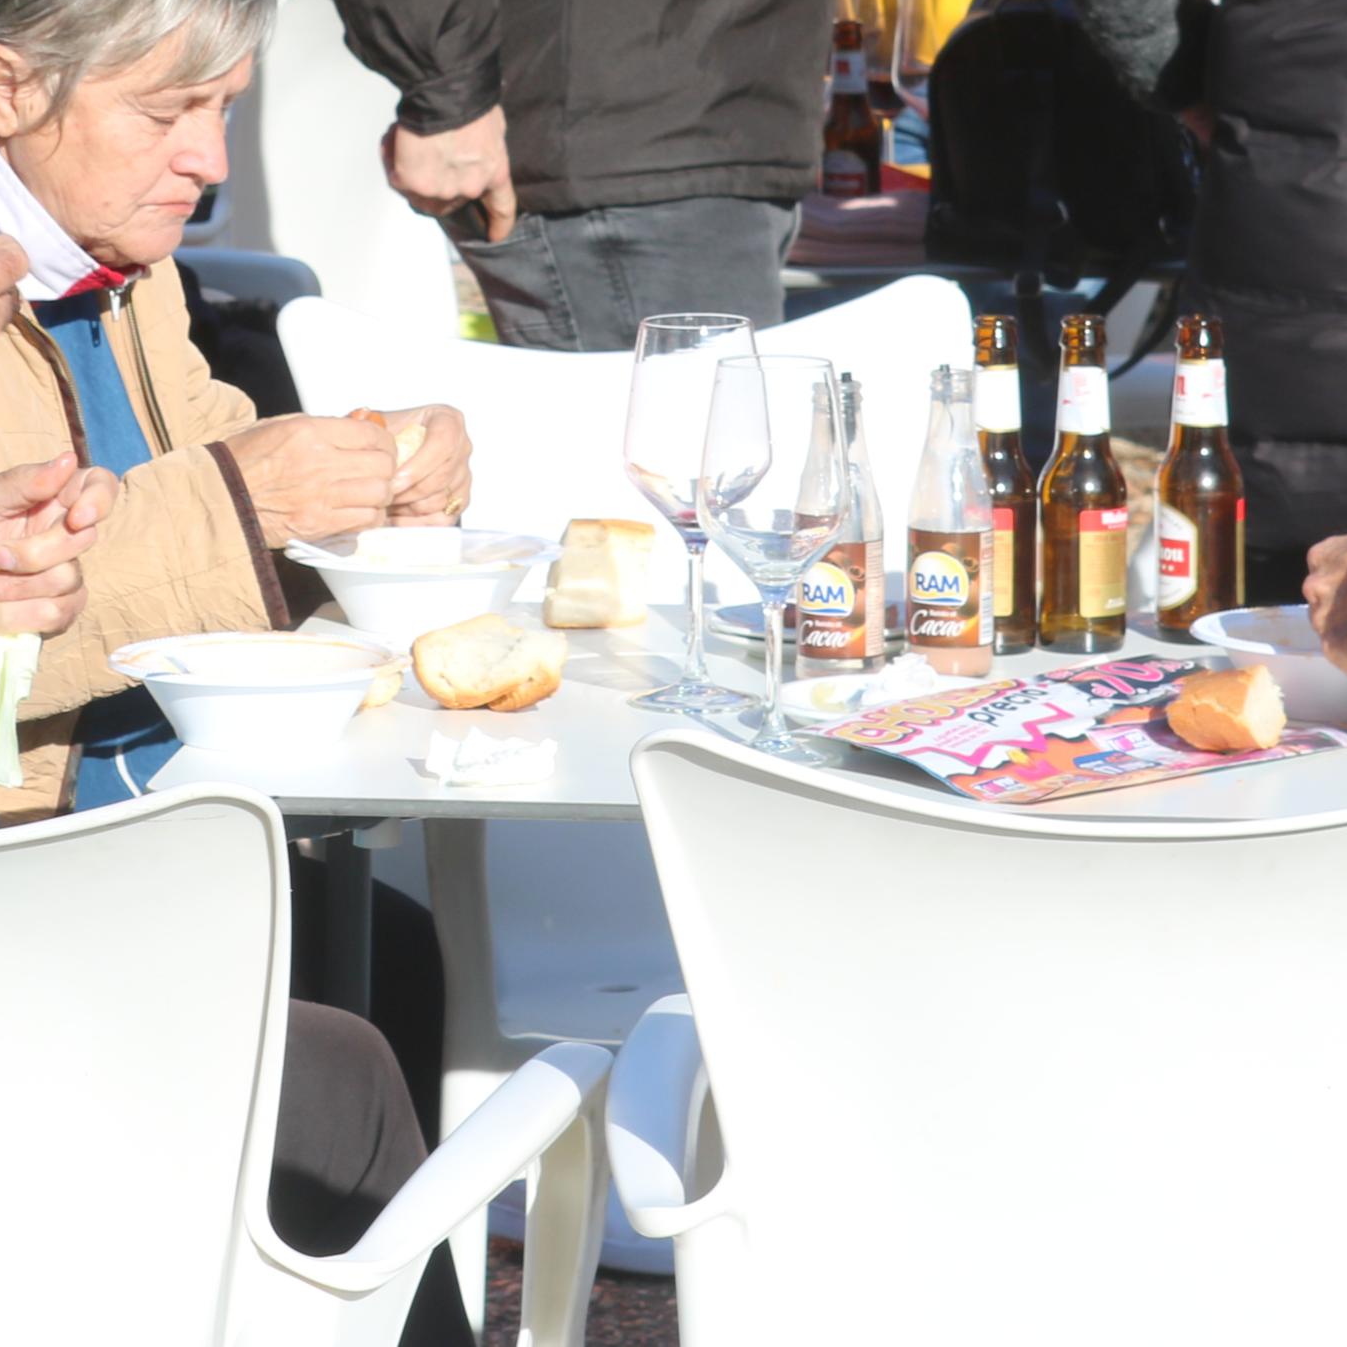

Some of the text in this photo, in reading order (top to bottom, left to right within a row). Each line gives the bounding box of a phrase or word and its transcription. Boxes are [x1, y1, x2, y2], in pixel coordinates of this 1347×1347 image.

[802, 582, 846, 605] RAM
[914, 572, 960, 594] RAM
[800, 619, 853, 648] Cacao
[909, 608, 965, 638] Cacao
